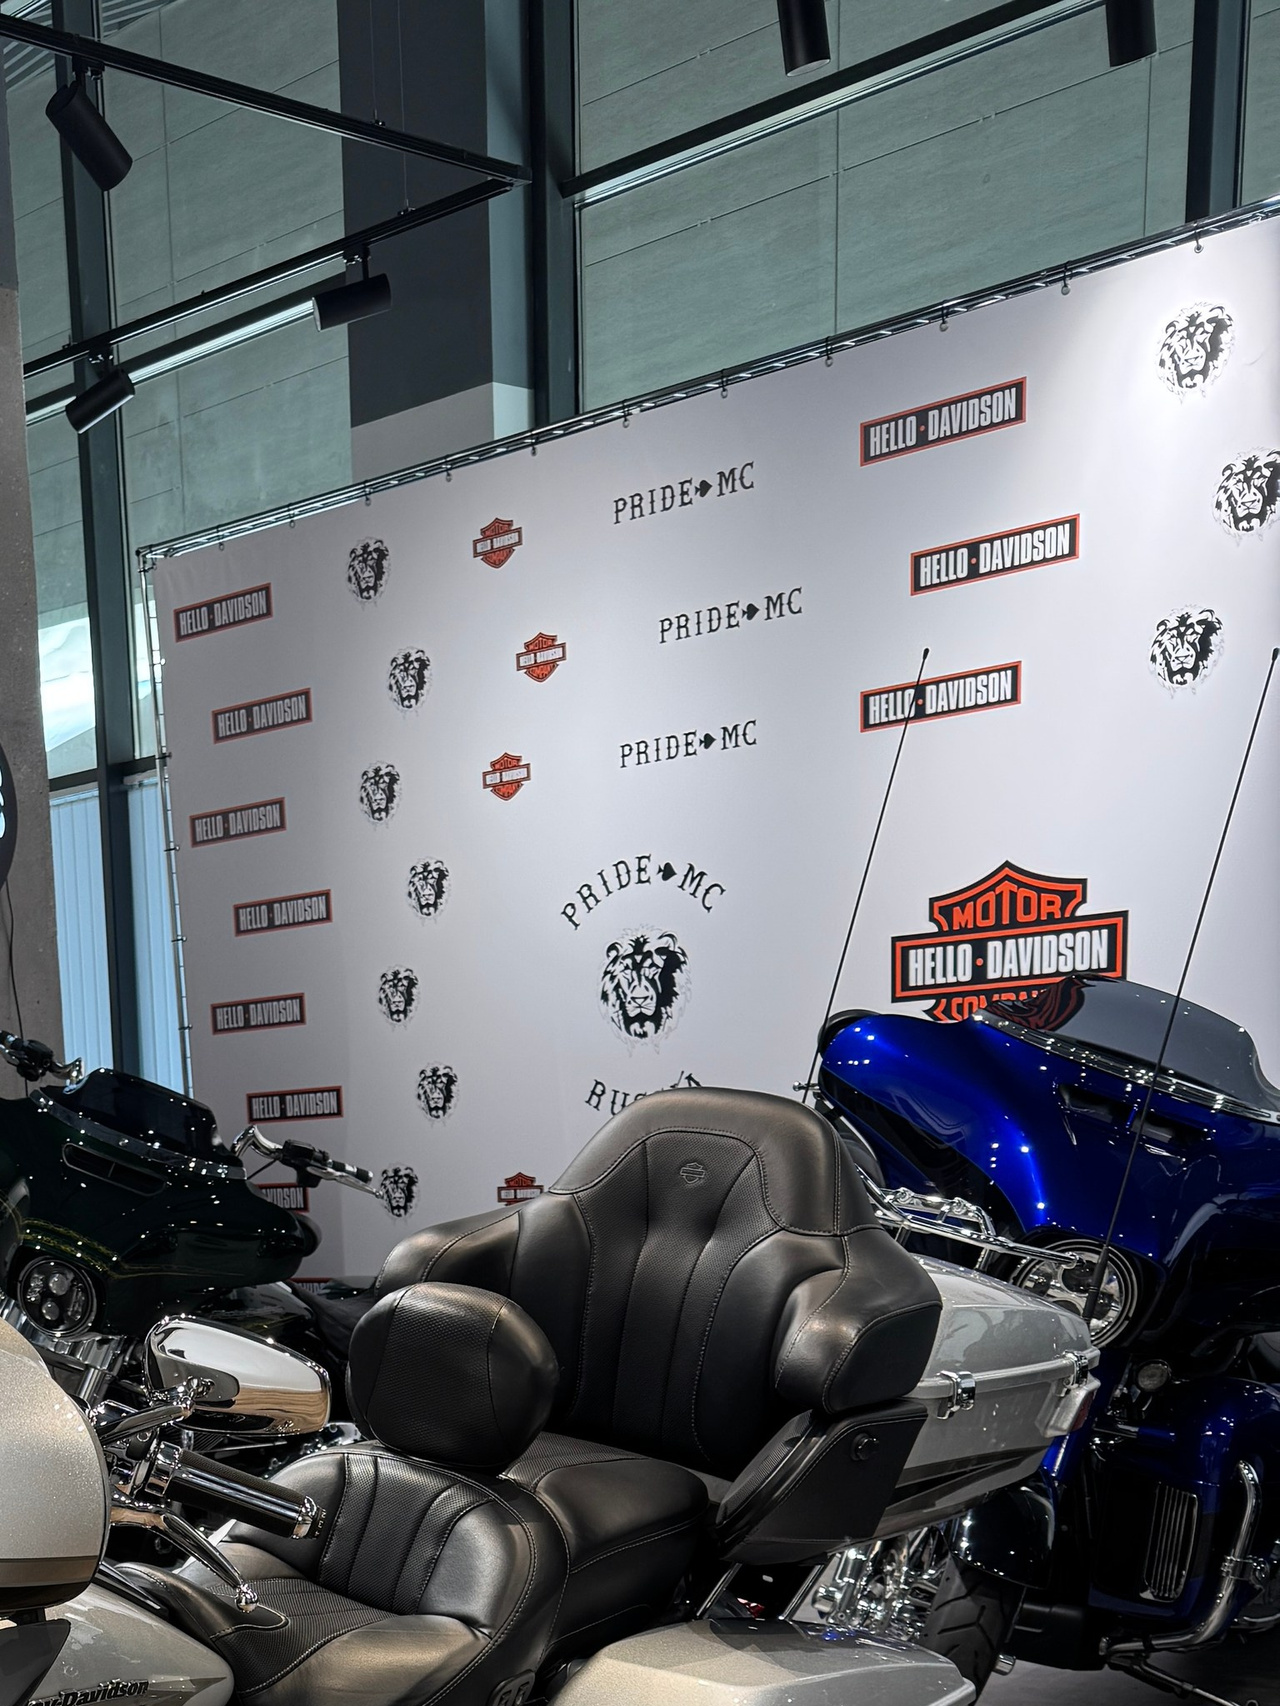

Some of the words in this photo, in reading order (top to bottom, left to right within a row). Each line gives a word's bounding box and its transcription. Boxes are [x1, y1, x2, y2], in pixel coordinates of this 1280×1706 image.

[870, 415, 917, 457] HELLO
[927, 387, 1017, 441] DAVIDSON
[613, 477, 694, 525] PRIDE
[716, 461, 755, 498] MC
[920, 547, 968, 588] HELLO
[979, 523, 1070, 574] DAVIDSON
[179, 606, 209, 636] HELLO
[213, 590, 267, 627] DAVIDSON
[659, 600, 741, 644] PRIDE
[764, 587, 803, 621] MC
[217, 709, 247, 737] HELLO
[252, 694, 307, 730] DAVIDSON
[869, 688, 916, 725] HELLO
[925, 669, 1012, 715] DAVIDSON
[619, 729, 698, 769] PRIDE
[720, 719, 757, 751] MC
[194, 815, 224, 842] HELLO
[228, 803, 281, 836] DAVIDSON
[238, 904, 268, 931] HELLO
[273, 895, 327, 926] DAVIDSON
[560, 854, 651, 931] PRIDE
[677, 863, 727, 914] MC
[952, 880, 1062, 930] MOTOR
[908, 943, 973, 987] HELLO
[986, 928, 1109, 980] DAVIDSON
[215, 1005, 245, 1030] HELLO
[250, 998, 301, 1026] DAVIDSON
[252, 1095, 281, 1120] HELLO
[286, 1090, 338, 1117] DAVIDSON
